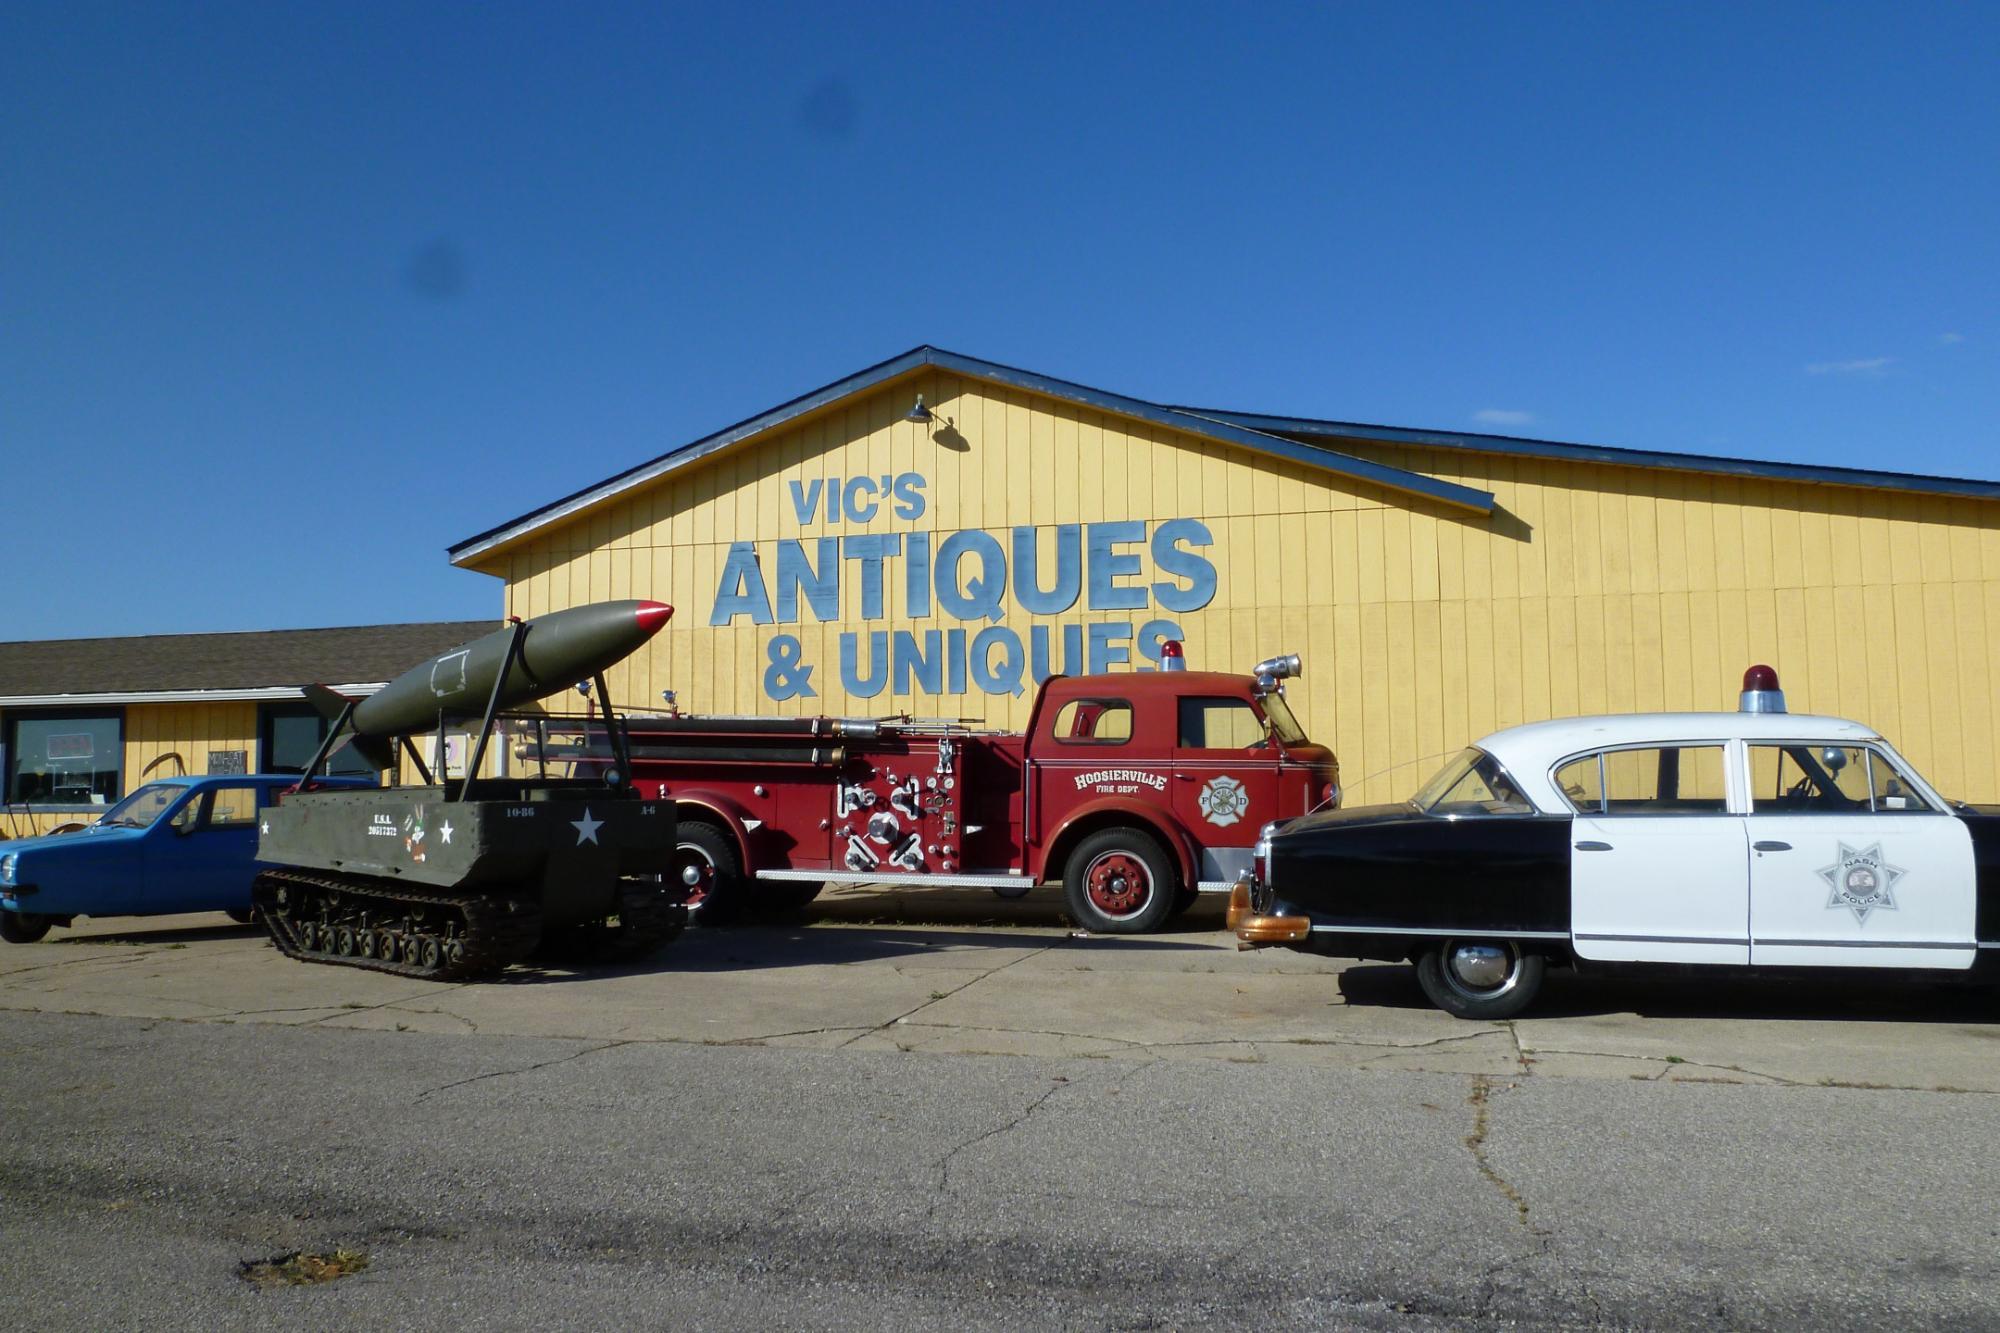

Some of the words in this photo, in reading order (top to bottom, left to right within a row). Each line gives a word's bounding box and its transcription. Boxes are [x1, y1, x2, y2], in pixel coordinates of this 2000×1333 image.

[789, 472, 927, 525] VIC'S
[709, 518, 1217, 626] ANTIQUES
[764, 634, 817, 700] &
[1074, 770, 1168, 791] HOOSIERVILLE
[1096, 785, 1115, 793] FIRE
[1117, 785, 1140, 793] DEPT.
[506, 807, 535, 818] 10-86
[1844, 858, 1878, 869] NASH
[1842, 891, 1881, 905] POLICE
